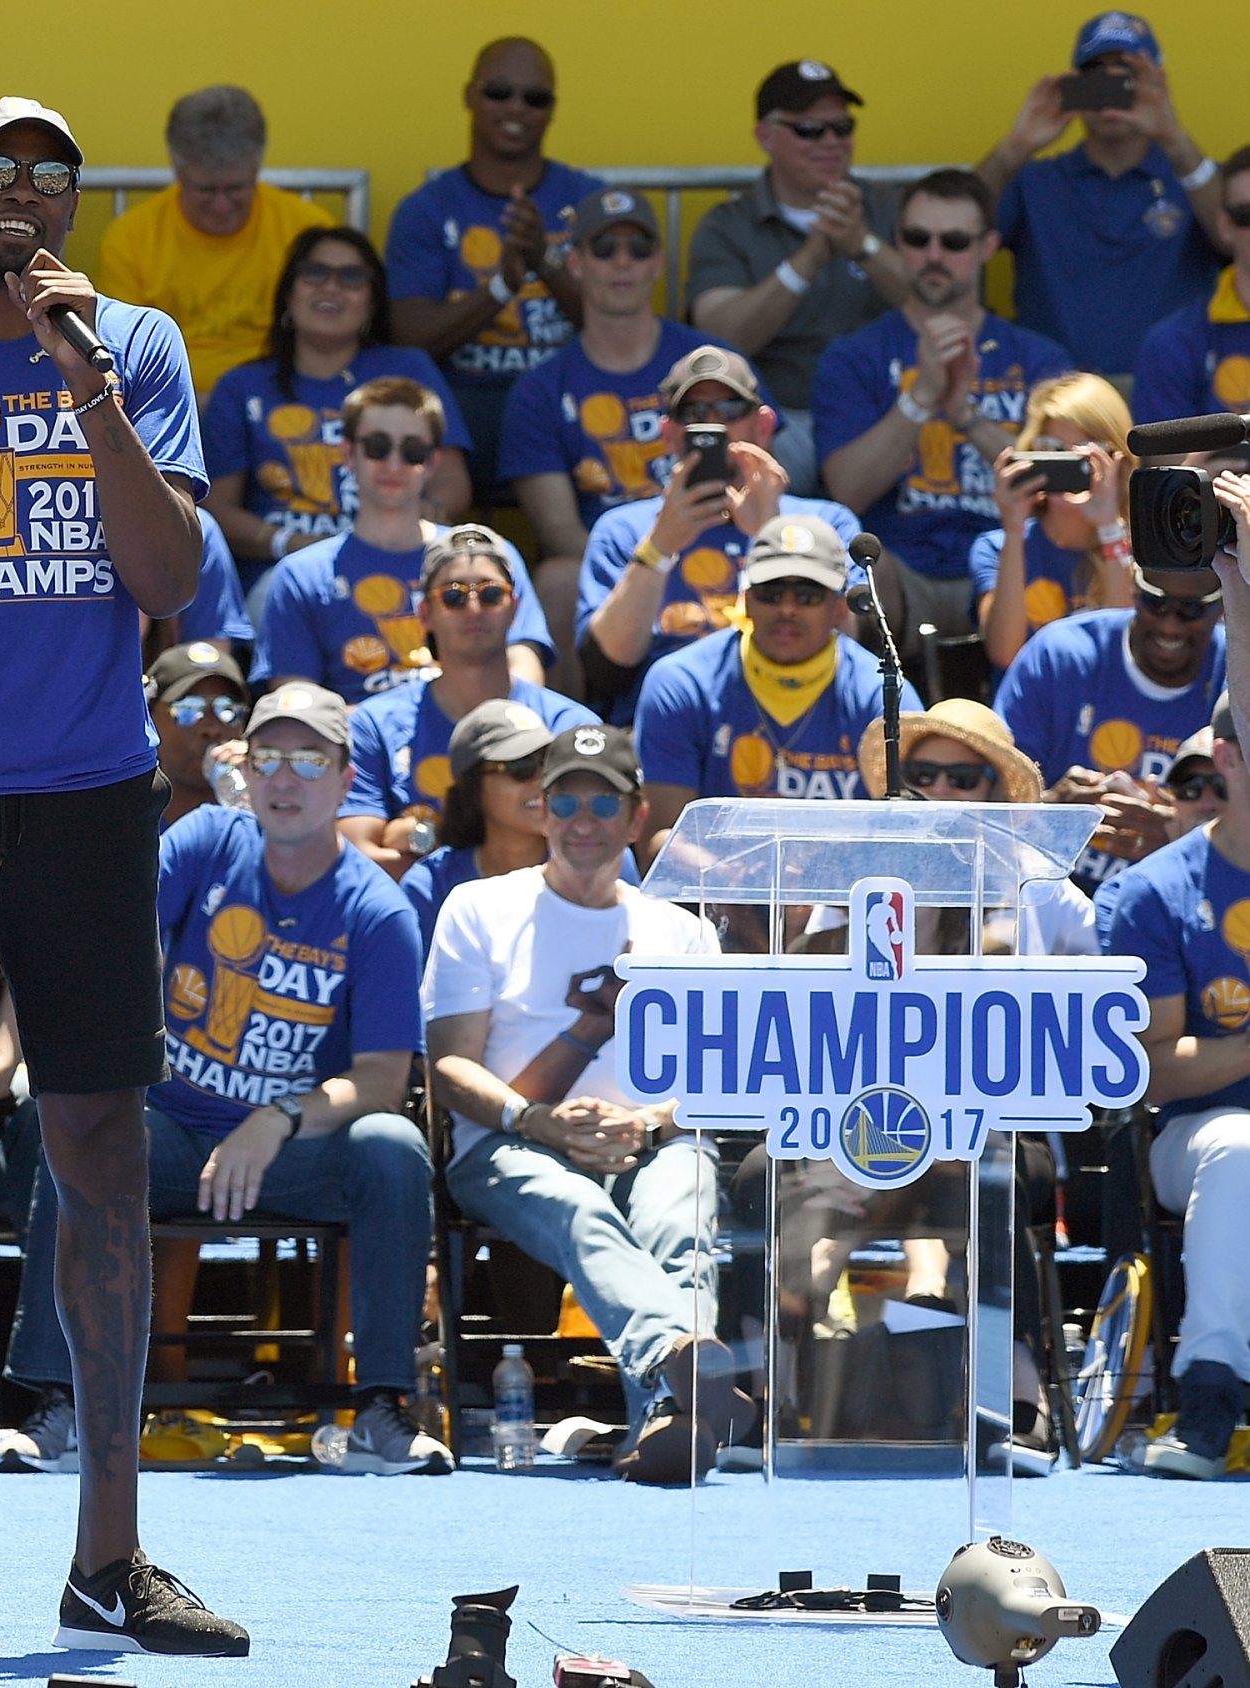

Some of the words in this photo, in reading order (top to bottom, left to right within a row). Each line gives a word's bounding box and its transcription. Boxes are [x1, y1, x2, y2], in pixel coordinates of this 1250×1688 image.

[451, 345, 556, 370] CHAM
[2, 391, 52, 413] THE
[87, 393, 105, 408] LOVE
[4, 412, 90, 452] DA
[18, 462, 64, 472] STRENGTH
[65, 462, 76, 470] IN
[28, 480, 101, 519] 201
[29, 520, 108, 551] NBA
[777, 767, 860, 800] DAY
[266, 932, 299, 955] THE
[298, 942, 347, 971] BAY'S
[258, 954, 346, 1005] DAY
[869, 961, 890, 977] NBA
[244, 1012, 329, 1051] 2017
[629, 989, 1141, 1097] CHAMPIONS
[238, 1041, 316, 1074] NBA
